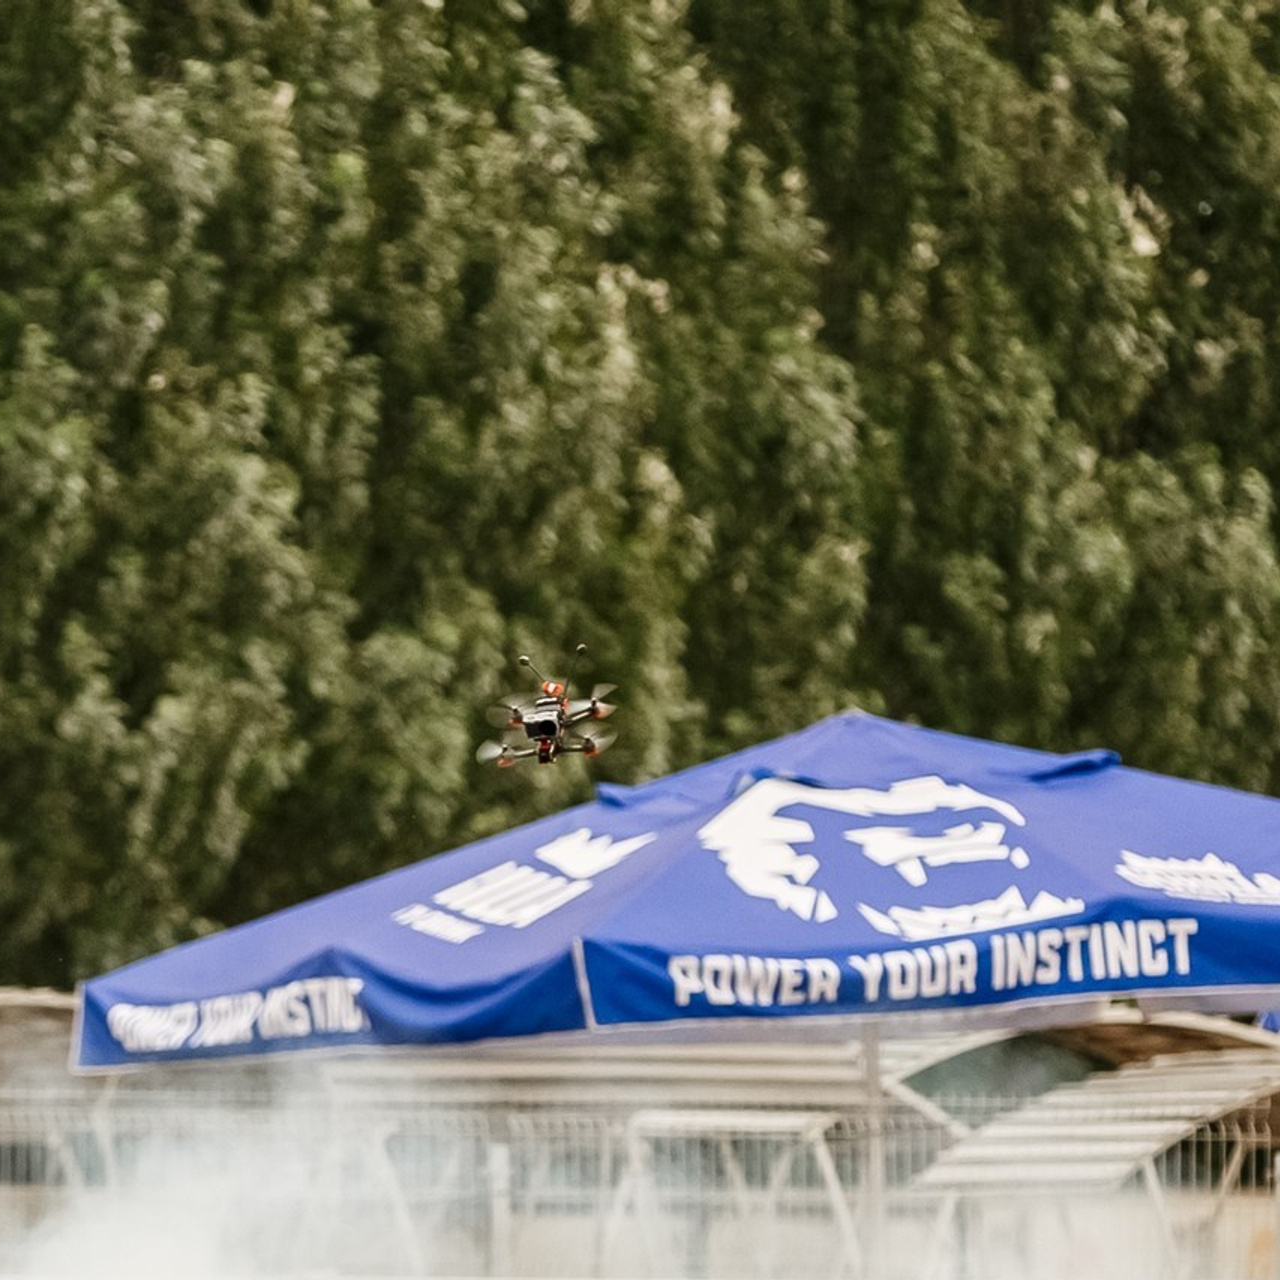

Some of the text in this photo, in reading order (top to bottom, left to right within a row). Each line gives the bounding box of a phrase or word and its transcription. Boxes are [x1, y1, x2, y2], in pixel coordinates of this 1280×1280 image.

[668, 917, 1198, 1007] POWER YOUR INSTINCT
